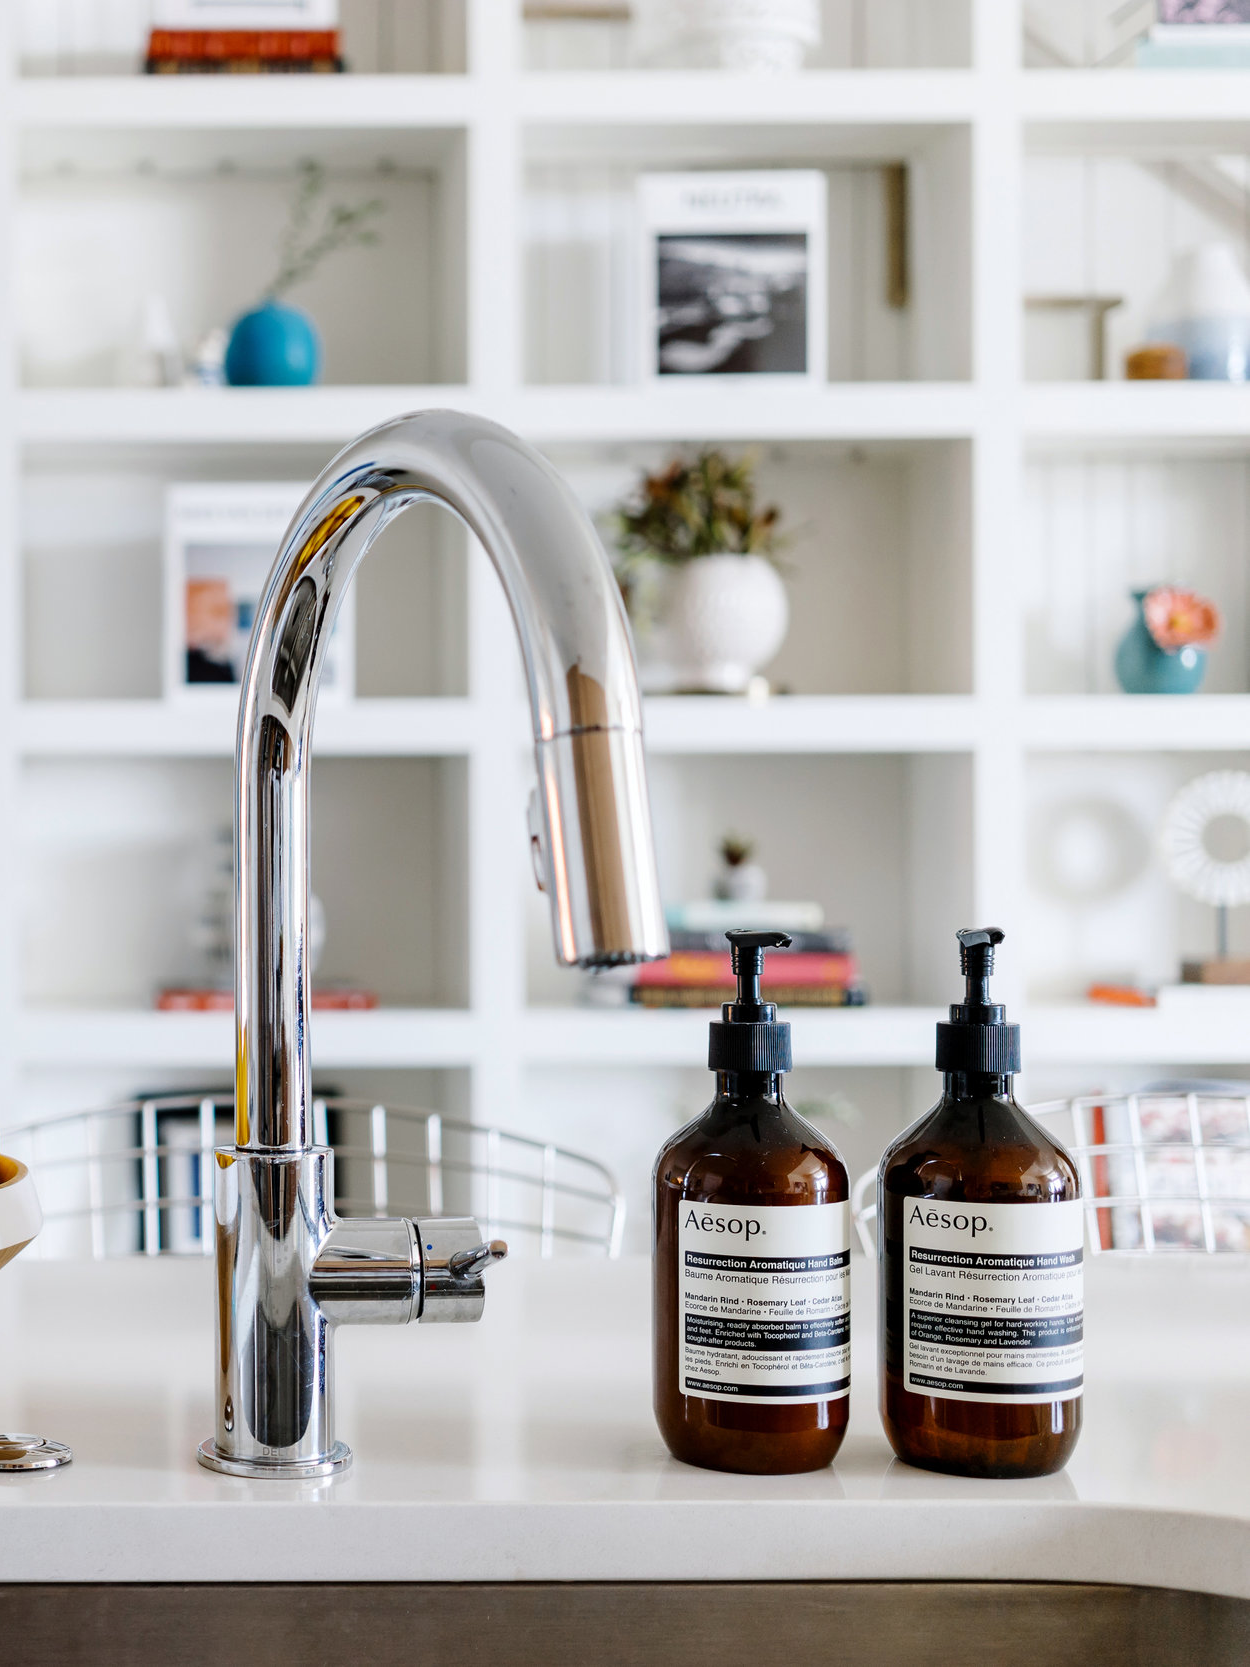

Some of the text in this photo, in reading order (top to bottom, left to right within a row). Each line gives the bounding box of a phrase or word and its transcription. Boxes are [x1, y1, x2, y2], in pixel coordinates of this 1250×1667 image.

[687, 1254, 843, 1271] Resurrection Aromatique Hand Balm
[911, 1250, 1075, 1268] Resurrection Aromatique Hand Wash
[685, 1269, 713, 1280] Baume
[716, 1274, 768, 1286] Aromatique
[772, 1274, 824, 1285] Résurrection
[909, 1265, 923, 1274] Gel
[925, 1267, 955, 1279] Lavant
[959, 1271, 1019, 1281] Résurrection
[1022, 1273, 1065, 1281] Aromatique
[685, 1292, 718, 1303] Mandarin
[720, 1297, 739, 1305] Rind
[747, 1299, 788, 1308] Rosemary
[791, 1298, 806, 1307] Leaf
[909, 1288, 943, 1298] Mandarin
[946, 1293, 965, 1301] Rind
[973, 1295, 1015, 1304] Rosemary
[1018, 1295, 1035, 1303] Leaf
[710, 1305, 719, 1313] de
[721, 1306, 761, 1316] Mandarine
[769, 1307, 793, 1316] Feuille
[796, 1306, 804, 1315] de
[806, 1305, 831, 1315] Romarin
[946, 1302, 987, 1312] Mandarine
[917, 1314, 942, 1323] superior
[945, 1317, 978, 1327] cleansing
[981, 1320, 992, 1328] gel
[1006, 1321, 1047, 1329] hard-working
[687, 1325, 697, 1333] and
[715, 1329, 745, 1338] Enriched
[765, 1332, 800, 1340] Tocopherol
[911, 1322, 932, 1331] require
[935, 1325, 963, 1334] effective
[988, 1330, 1018, 1338] washing.
[1039, 1329, 1059, 1338] product
[687, 1335, 756, 1348] sought-after products.
[946, 1336, 981, 1345] Rosemary
[685, 1347, 705, 1356] Baume
[707, 1349, 739, 1361] hydratant,
[742, 1353, 783, 1361] adoucissant
[909, 1351, 928, 1360] besoin
[946, 1357, 969, 1366] lavage
[920, 1344, 939, 1353] lavant
[941, 1349, 985, 1358] exceptionnel
[986, 1351, 1002, 1359] pour
[685, 1364, 721, 1376] chez Aesop.
[695, 1358, 711, 1366] pieds.
[715, 1361, 738, 1369] Enrichi
[753, 1363, 789, 1372] Tocophérol
[909, 1360, 934, 1370] Romarin
[955, 1364, 987, 1376] Lavande.
[687, 1380, 738, 1392] www.aesop.com
[911, 1376, 963, 1389] www.aesop.com
